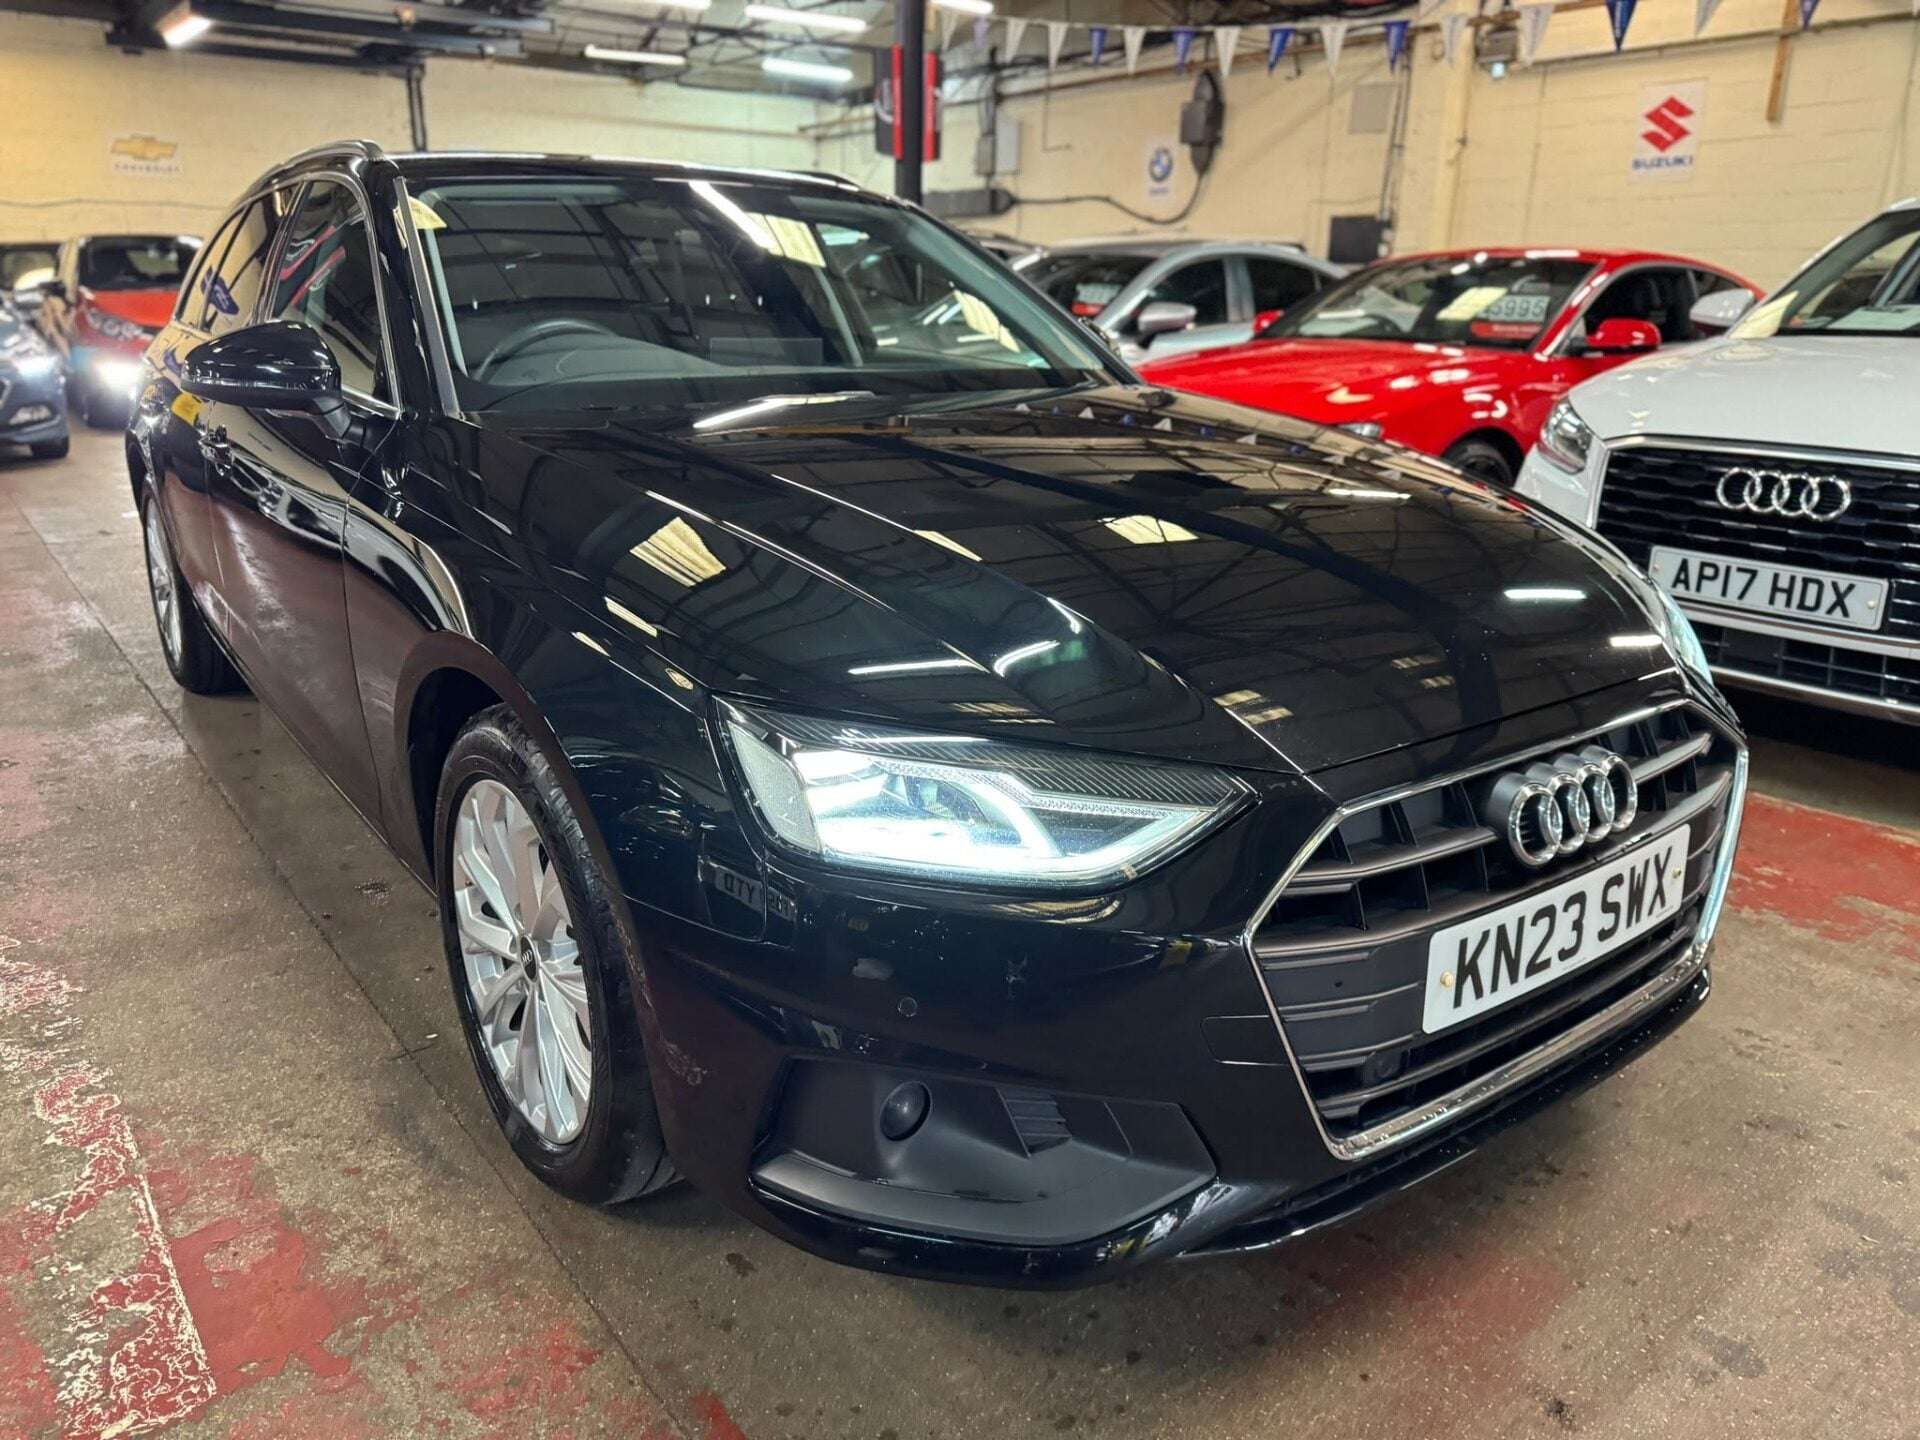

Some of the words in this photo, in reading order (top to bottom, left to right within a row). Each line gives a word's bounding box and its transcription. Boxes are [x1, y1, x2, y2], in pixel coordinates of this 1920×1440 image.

[1671, 558, 1758, 600] AP17
[1768, 572, 1855, 618] HDX
[1453, 890, 1587, 1009] KN23
[1597, 846, 1673, 942] SWX
